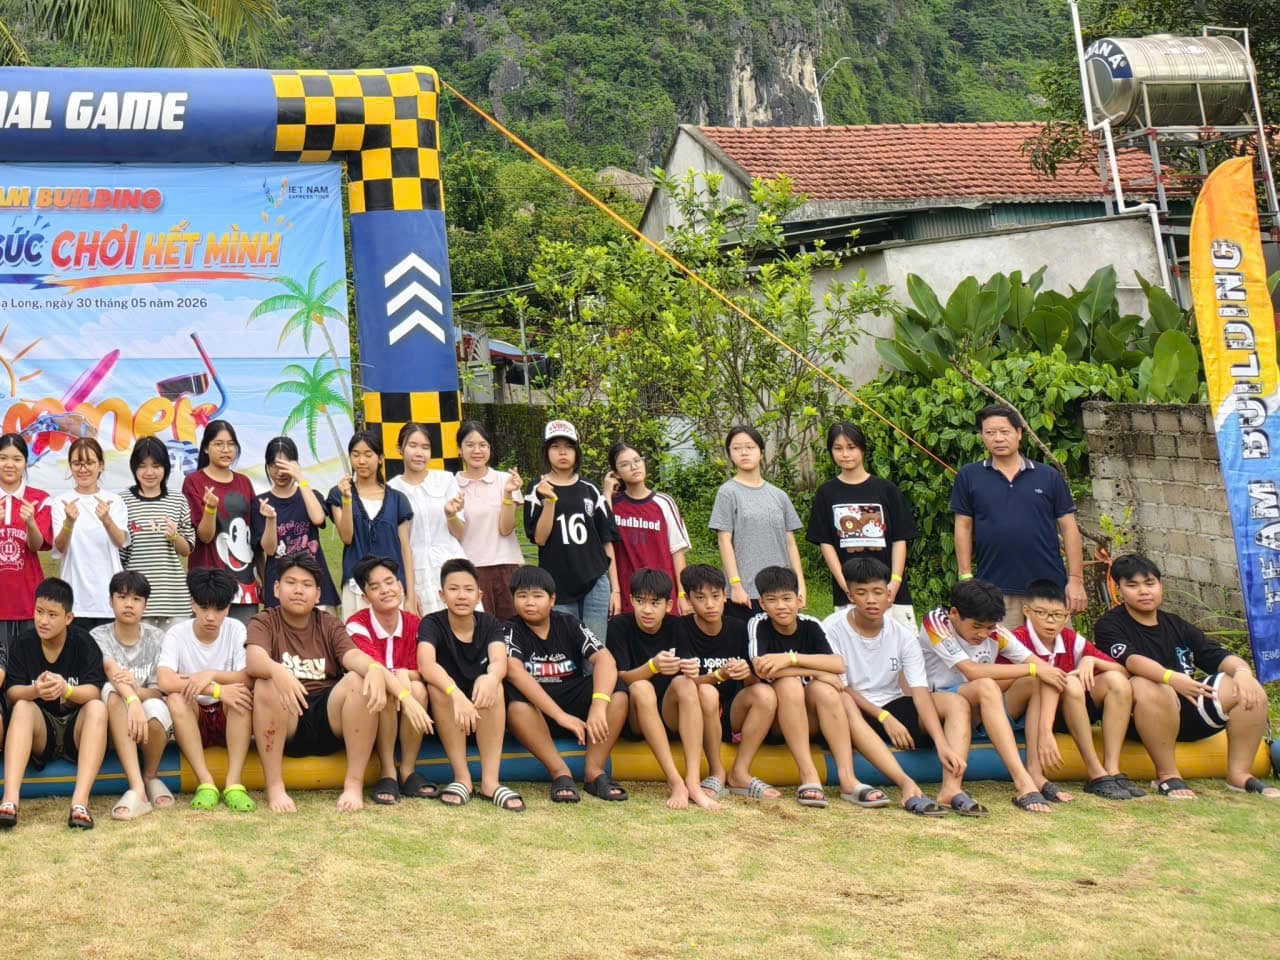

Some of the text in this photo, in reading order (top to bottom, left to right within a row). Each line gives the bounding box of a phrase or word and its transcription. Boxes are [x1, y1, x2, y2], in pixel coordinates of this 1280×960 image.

[65, 92, 188, 130] GAME
[36, 187, 162, 209] BUILDING
[51, 223, 139, 268] CHƠI
[142, 220, 201, 266] HẾT
[203, 223, 281, 266] MÌNH
[11, 298, 42, 313] Long,
[45, 298, 73, 310] ngày
[76, 298, 91, 308] 30
[95, 298, 128, 310] tháng
[131, 298, 147, 308] 05
[149, 298, 174, 308] năm
[177, 298, 207, 308] 2026
[1211, 240, 1269, 459] BUILDING
[557, 513, 588, 545] 16
